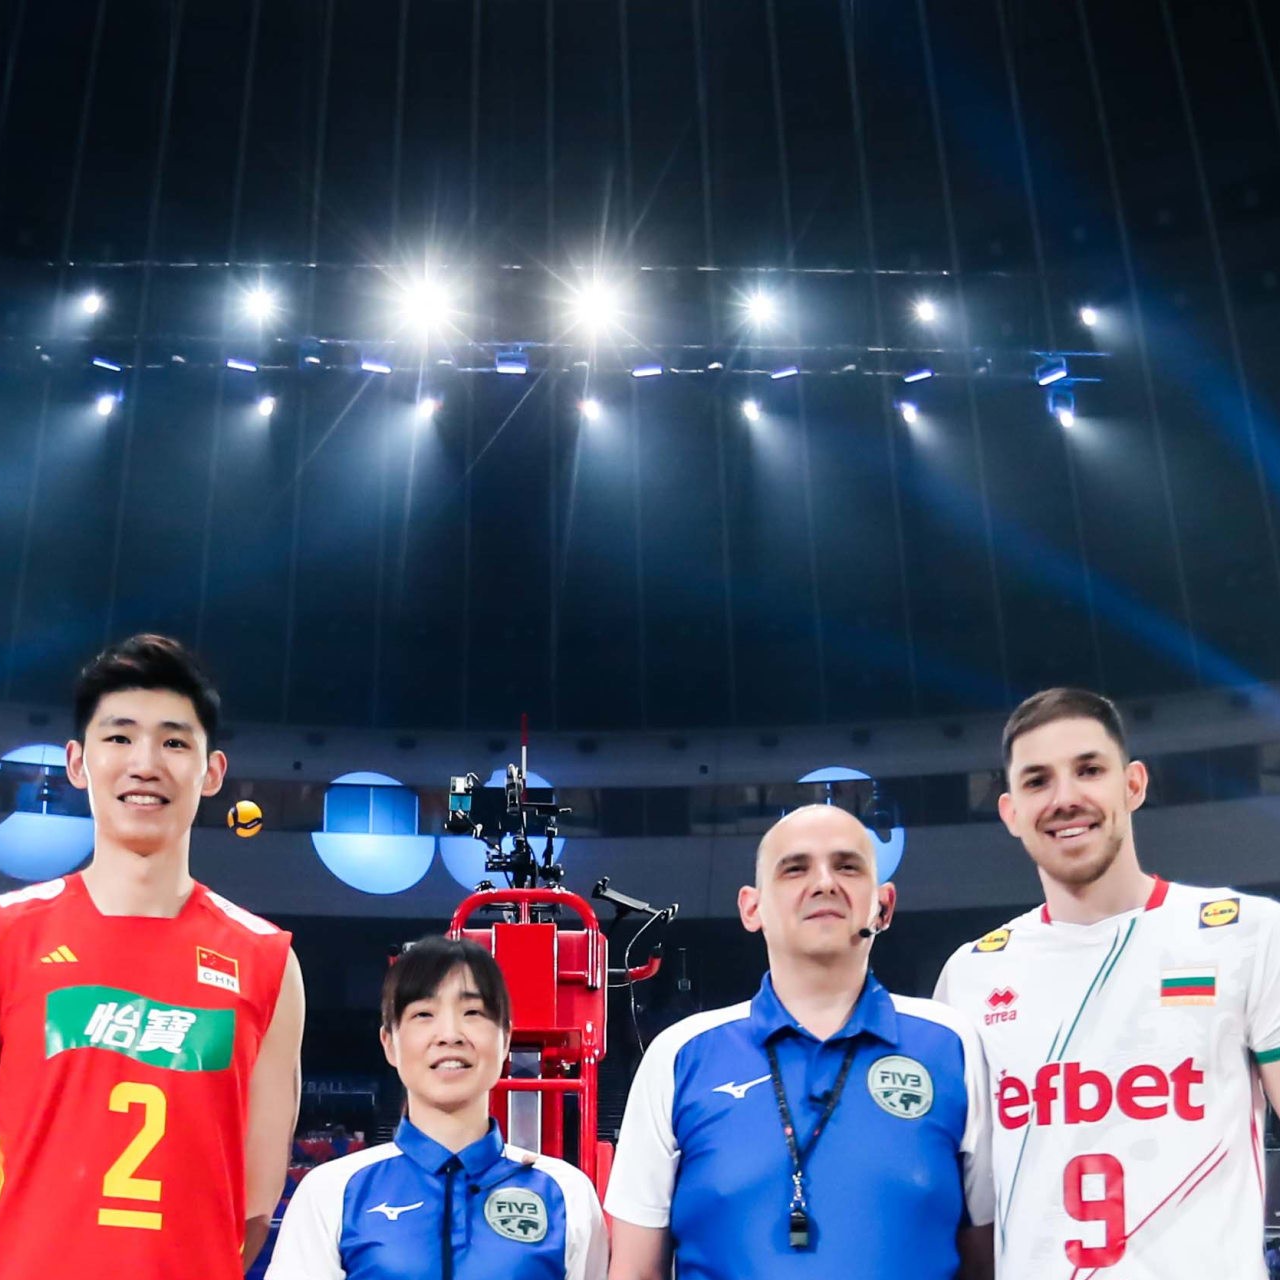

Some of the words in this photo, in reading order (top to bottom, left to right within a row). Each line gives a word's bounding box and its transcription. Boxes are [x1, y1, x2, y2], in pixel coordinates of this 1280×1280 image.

[202, 971, 236, 988] CHN
[880, 1070, 922, 1088] FIVB
[997, 1057, 1206, 1130] efbet
[103, 1081, 167, 1202] 2
[495, 1201, 539, 1215] FIVB
[1063, 1153, 1126, 1268] 9
